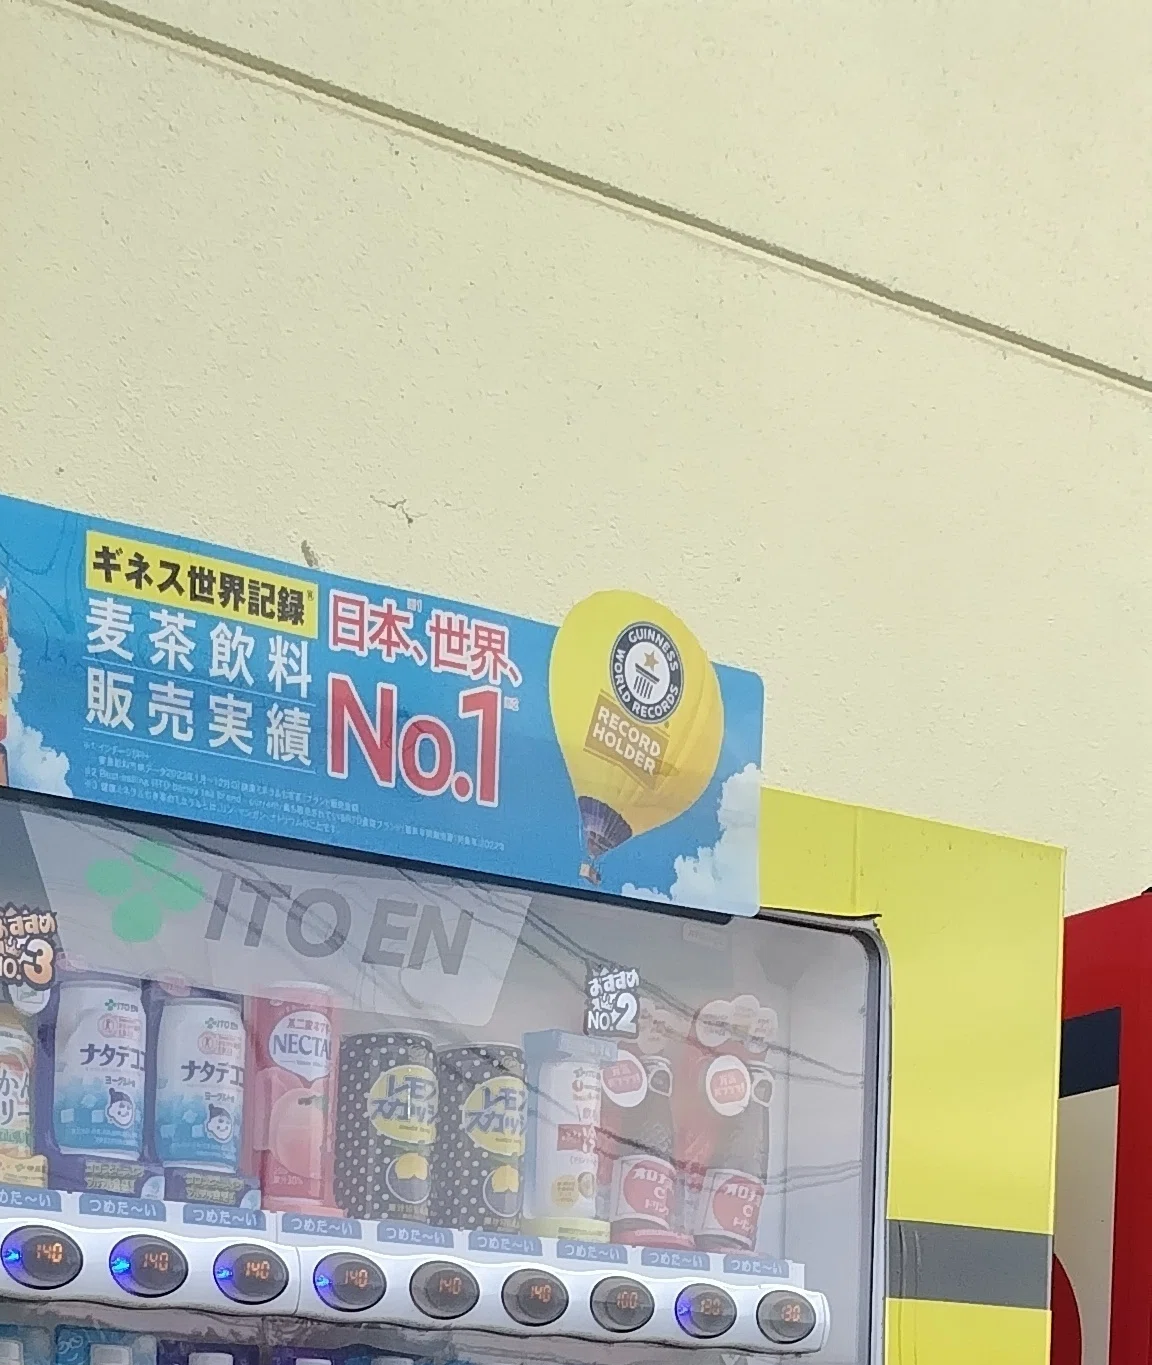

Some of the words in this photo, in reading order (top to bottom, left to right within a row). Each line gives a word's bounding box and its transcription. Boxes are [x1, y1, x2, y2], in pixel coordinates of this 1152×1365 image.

[85, 597, 313, 699] 麦茶飲料
[628, 629, 679, 673] GUINNESS
[613, 649, 632, 704] WORLD
[631, 682, 680, 719] RECORDS
[85, 666, 312, 766] 販売実績
[327, 672, 501, 807] No.1
[597, 704, 662, 758] RECORD
[591, 723, 657, 775] HOLDER
[205, 870, 353, 959] ITO
[361, 901, 474, 976] EN
[587, 967, 640, 996] おすすめ
[586, 993, 639, 1034] NO.2
[35, 1242, 63, 1263] 140
[143, 1252, 169, 1272] 140
[244, 1260, 271, 1280] 140
[343, 1269, 369, 1288] 140
